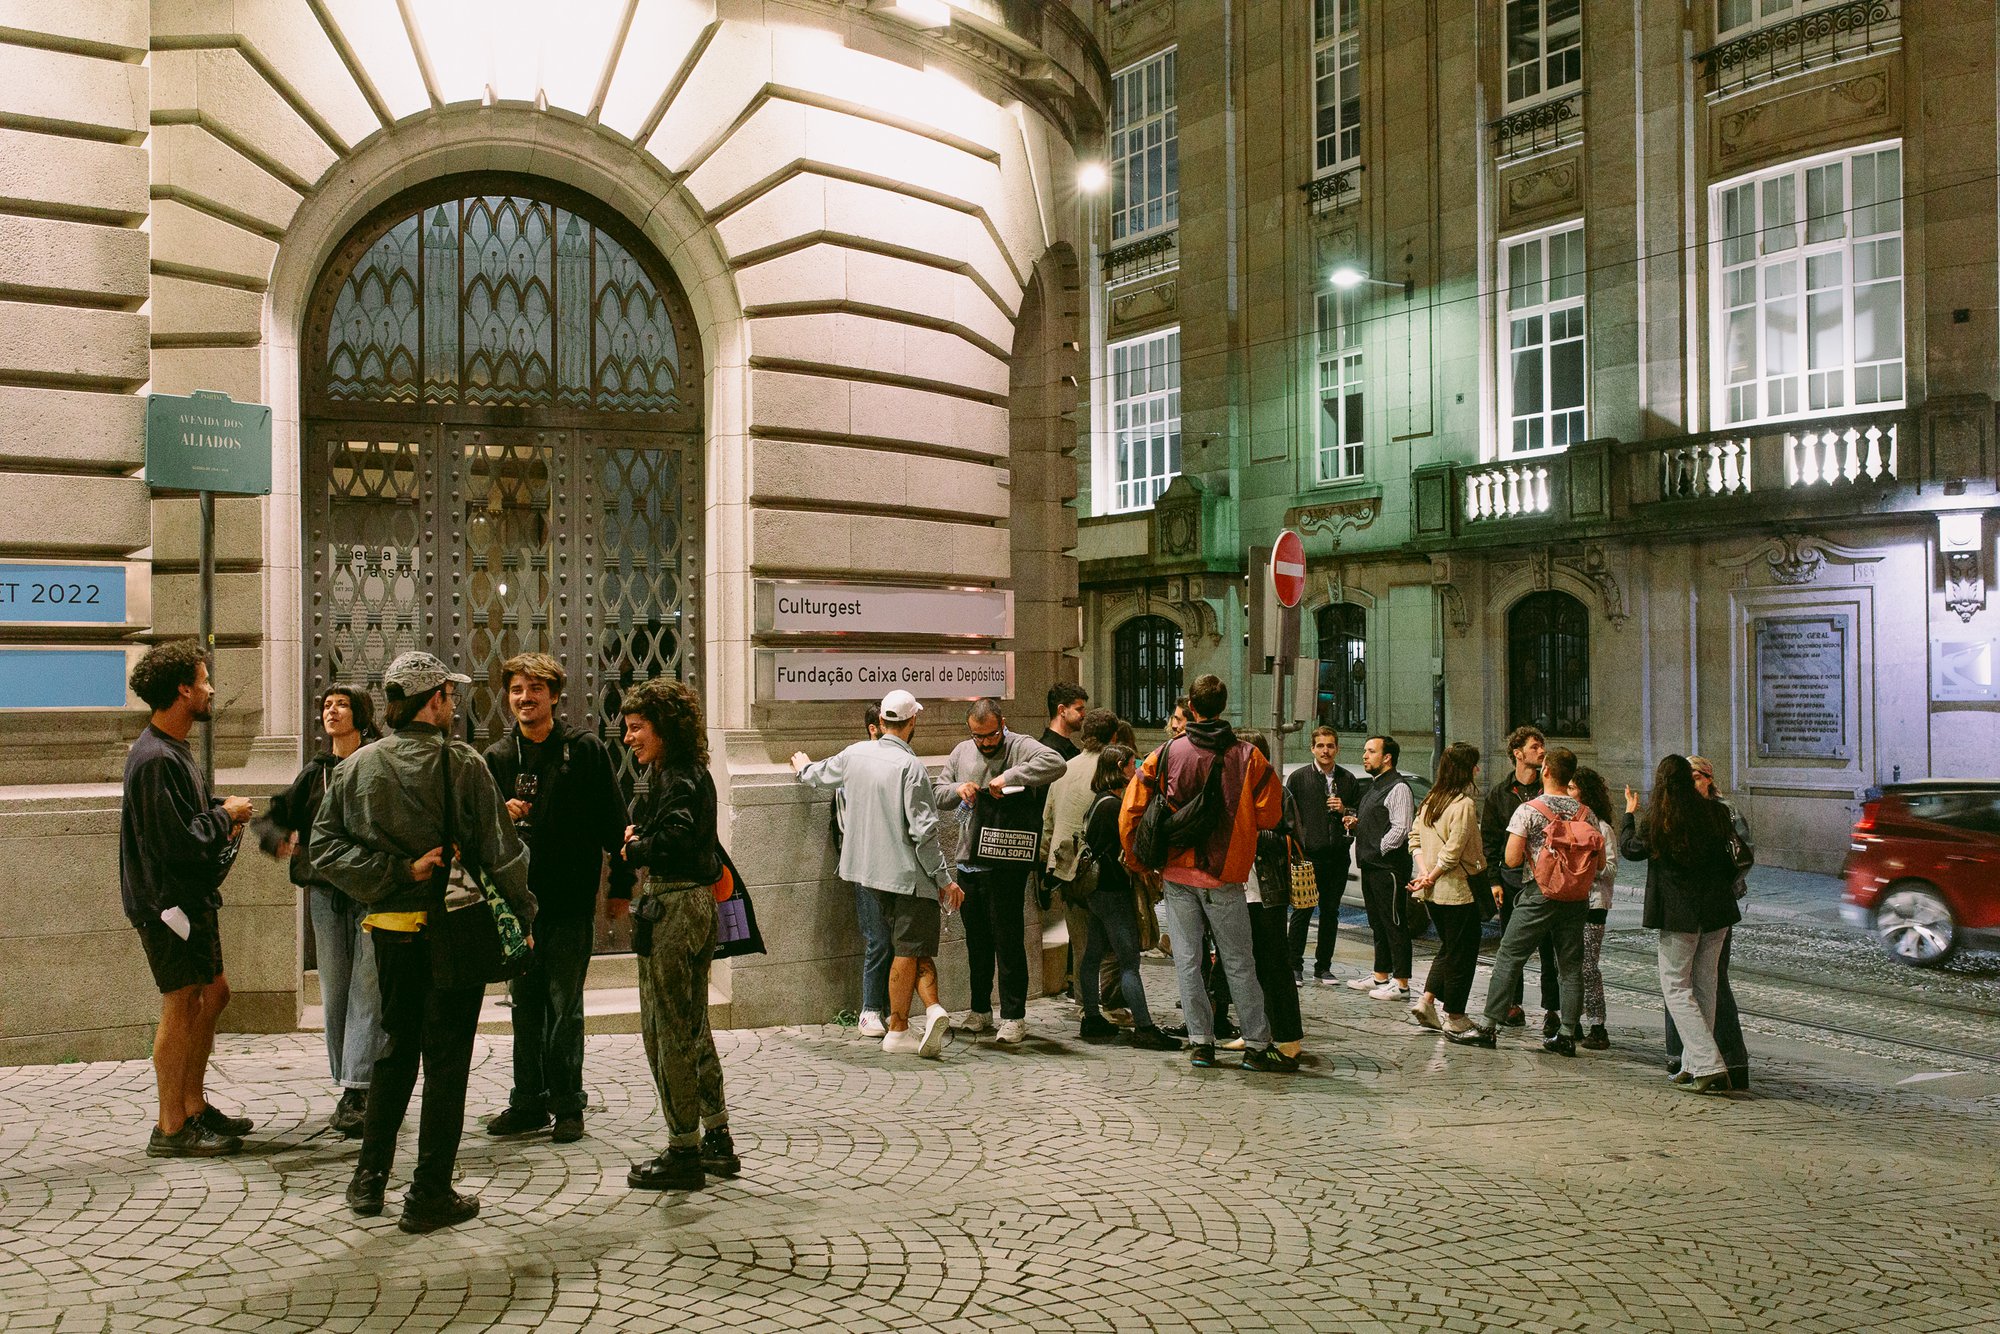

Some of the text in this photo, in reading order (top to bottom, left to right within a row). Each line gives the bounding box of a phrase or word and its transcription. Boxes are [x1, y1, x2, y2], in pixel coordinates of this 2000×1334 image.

[179, 414, 243, 429] AVENIDA DOS
[181, 433, 241, 449] ALIADOS
[31, 583, 100, 603] 2022
[778, 597, 862, 618] Culturgest
[777, 666, 1005, 686] Fundação Caixa Geral de Depósitos
[981, 846, 1031, 858] REINA SOFIA
